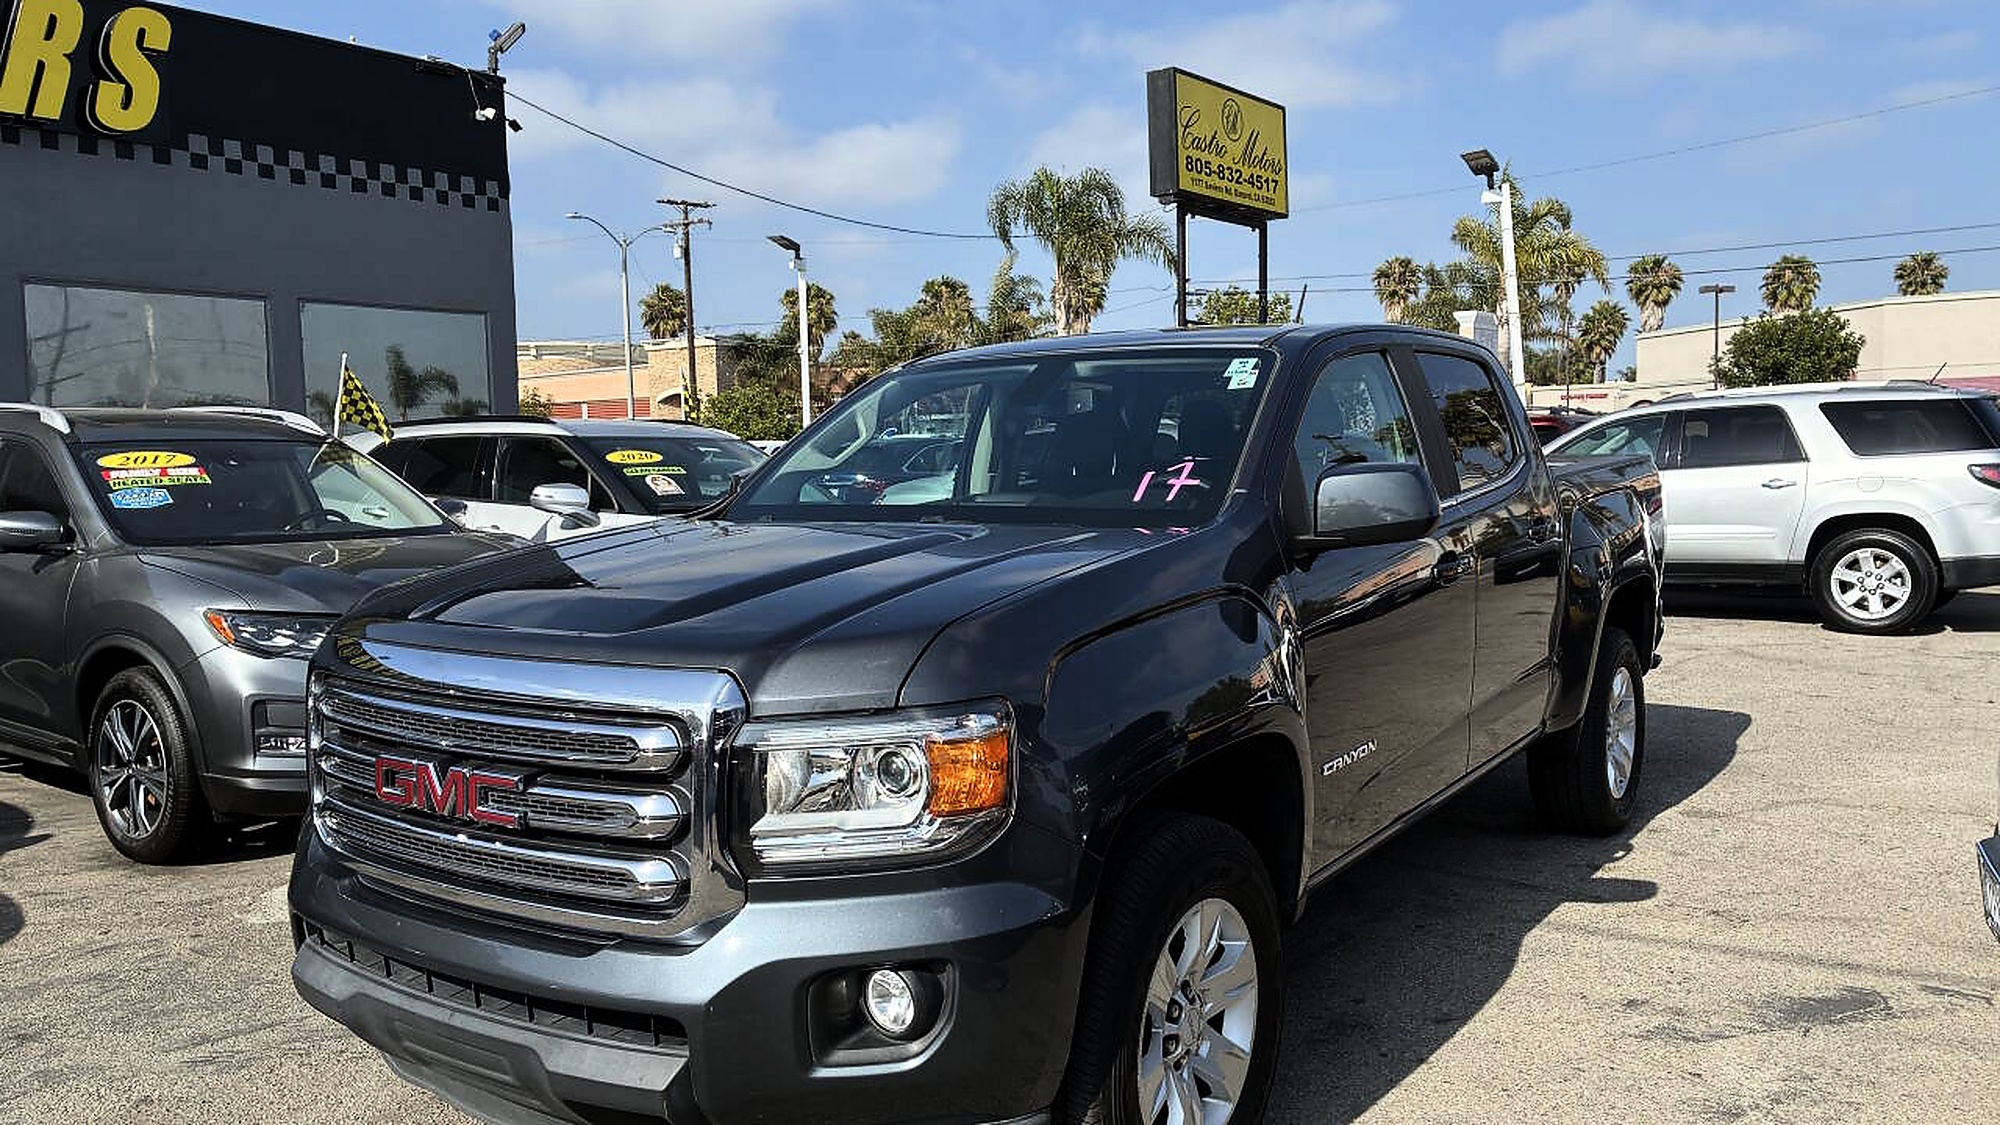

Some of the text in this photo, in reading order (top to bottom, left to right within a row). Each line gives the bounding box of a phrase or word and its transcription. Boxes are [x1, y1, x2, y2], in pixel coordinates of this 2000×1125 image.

[1179, 106, 1283, 176] Castro Motors
[1185, 155, 1279, 195] 805-832-4517
[117, 454, 176, 466] 2017
[619, 452, 653, 462] 2020
[112, 475, 209, 489] HEATED SEATS
[1132, 460, 1201, 503] 17
[1322, 738, 1378, 776] CANYON
[374, 756, 528, 830] GMC
